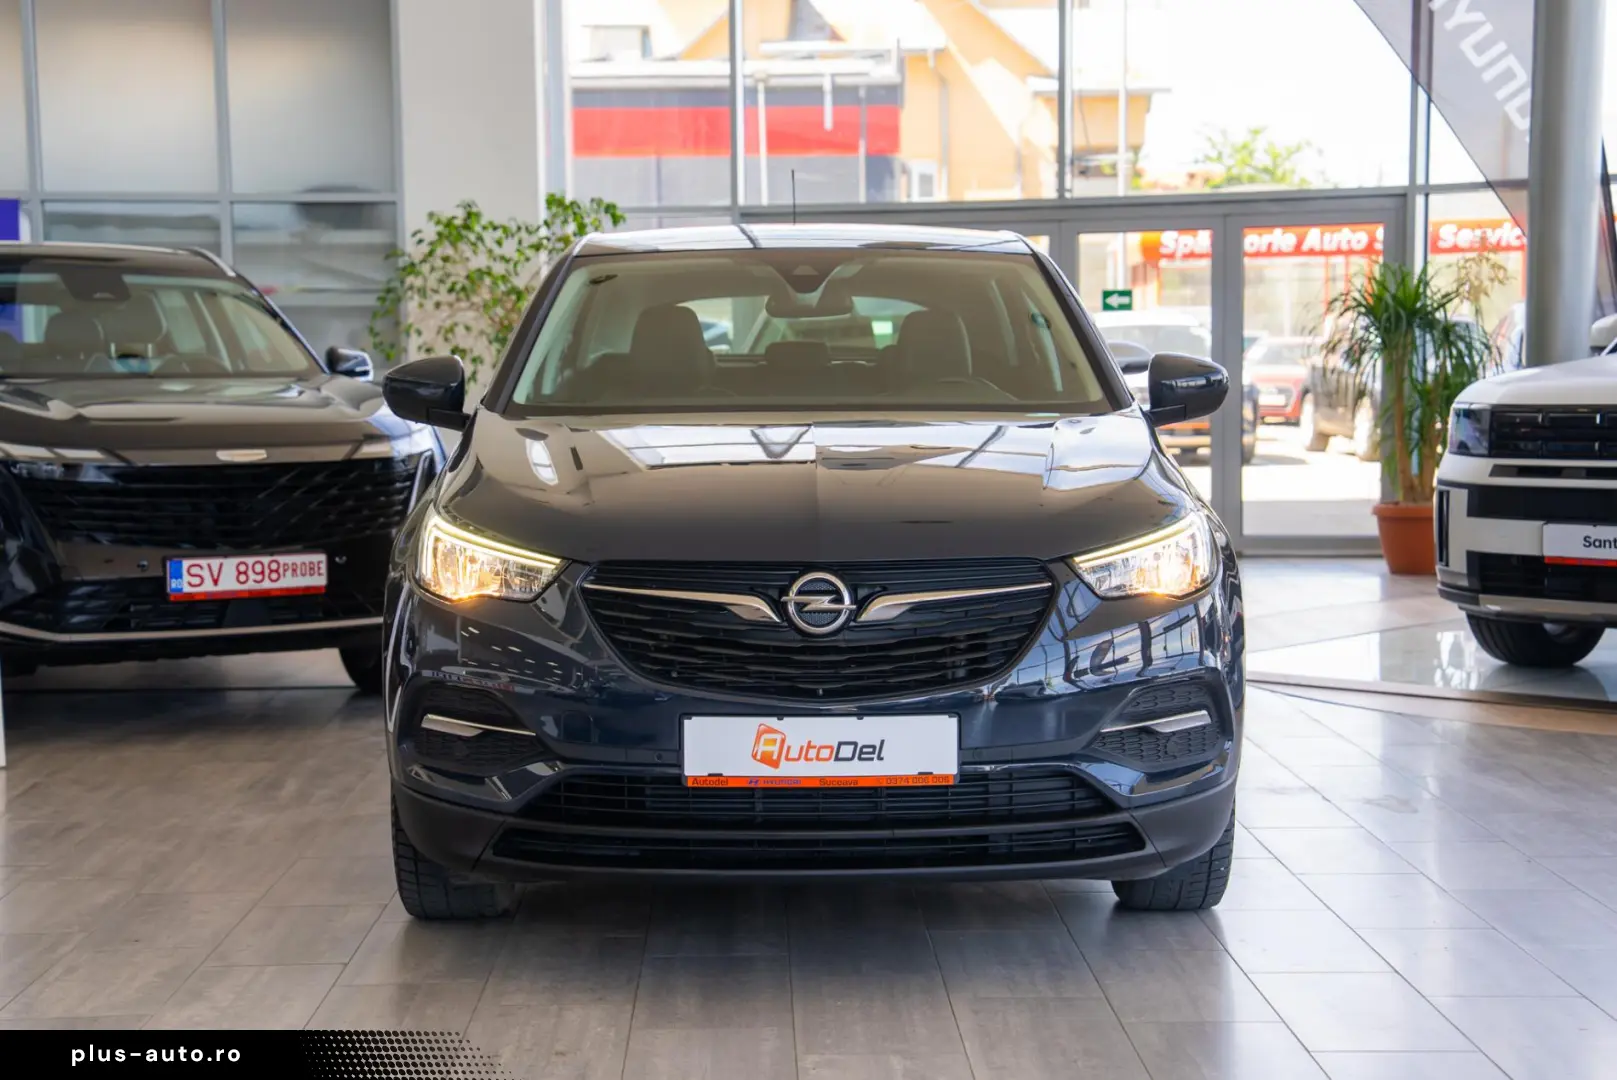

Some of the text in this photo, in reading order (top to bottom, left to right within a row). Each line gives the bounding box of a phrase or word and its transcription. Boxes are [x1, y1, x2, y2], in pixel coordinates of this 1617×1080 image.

[1302, 227, 1369, 251] Auto
[186, 559, 324, 588] SV 898 PROBE
[752, 728, 885, 766] AutoDel
[691, 777, 728, 786] Autodel
[886, 776, 910, 785] 0374
